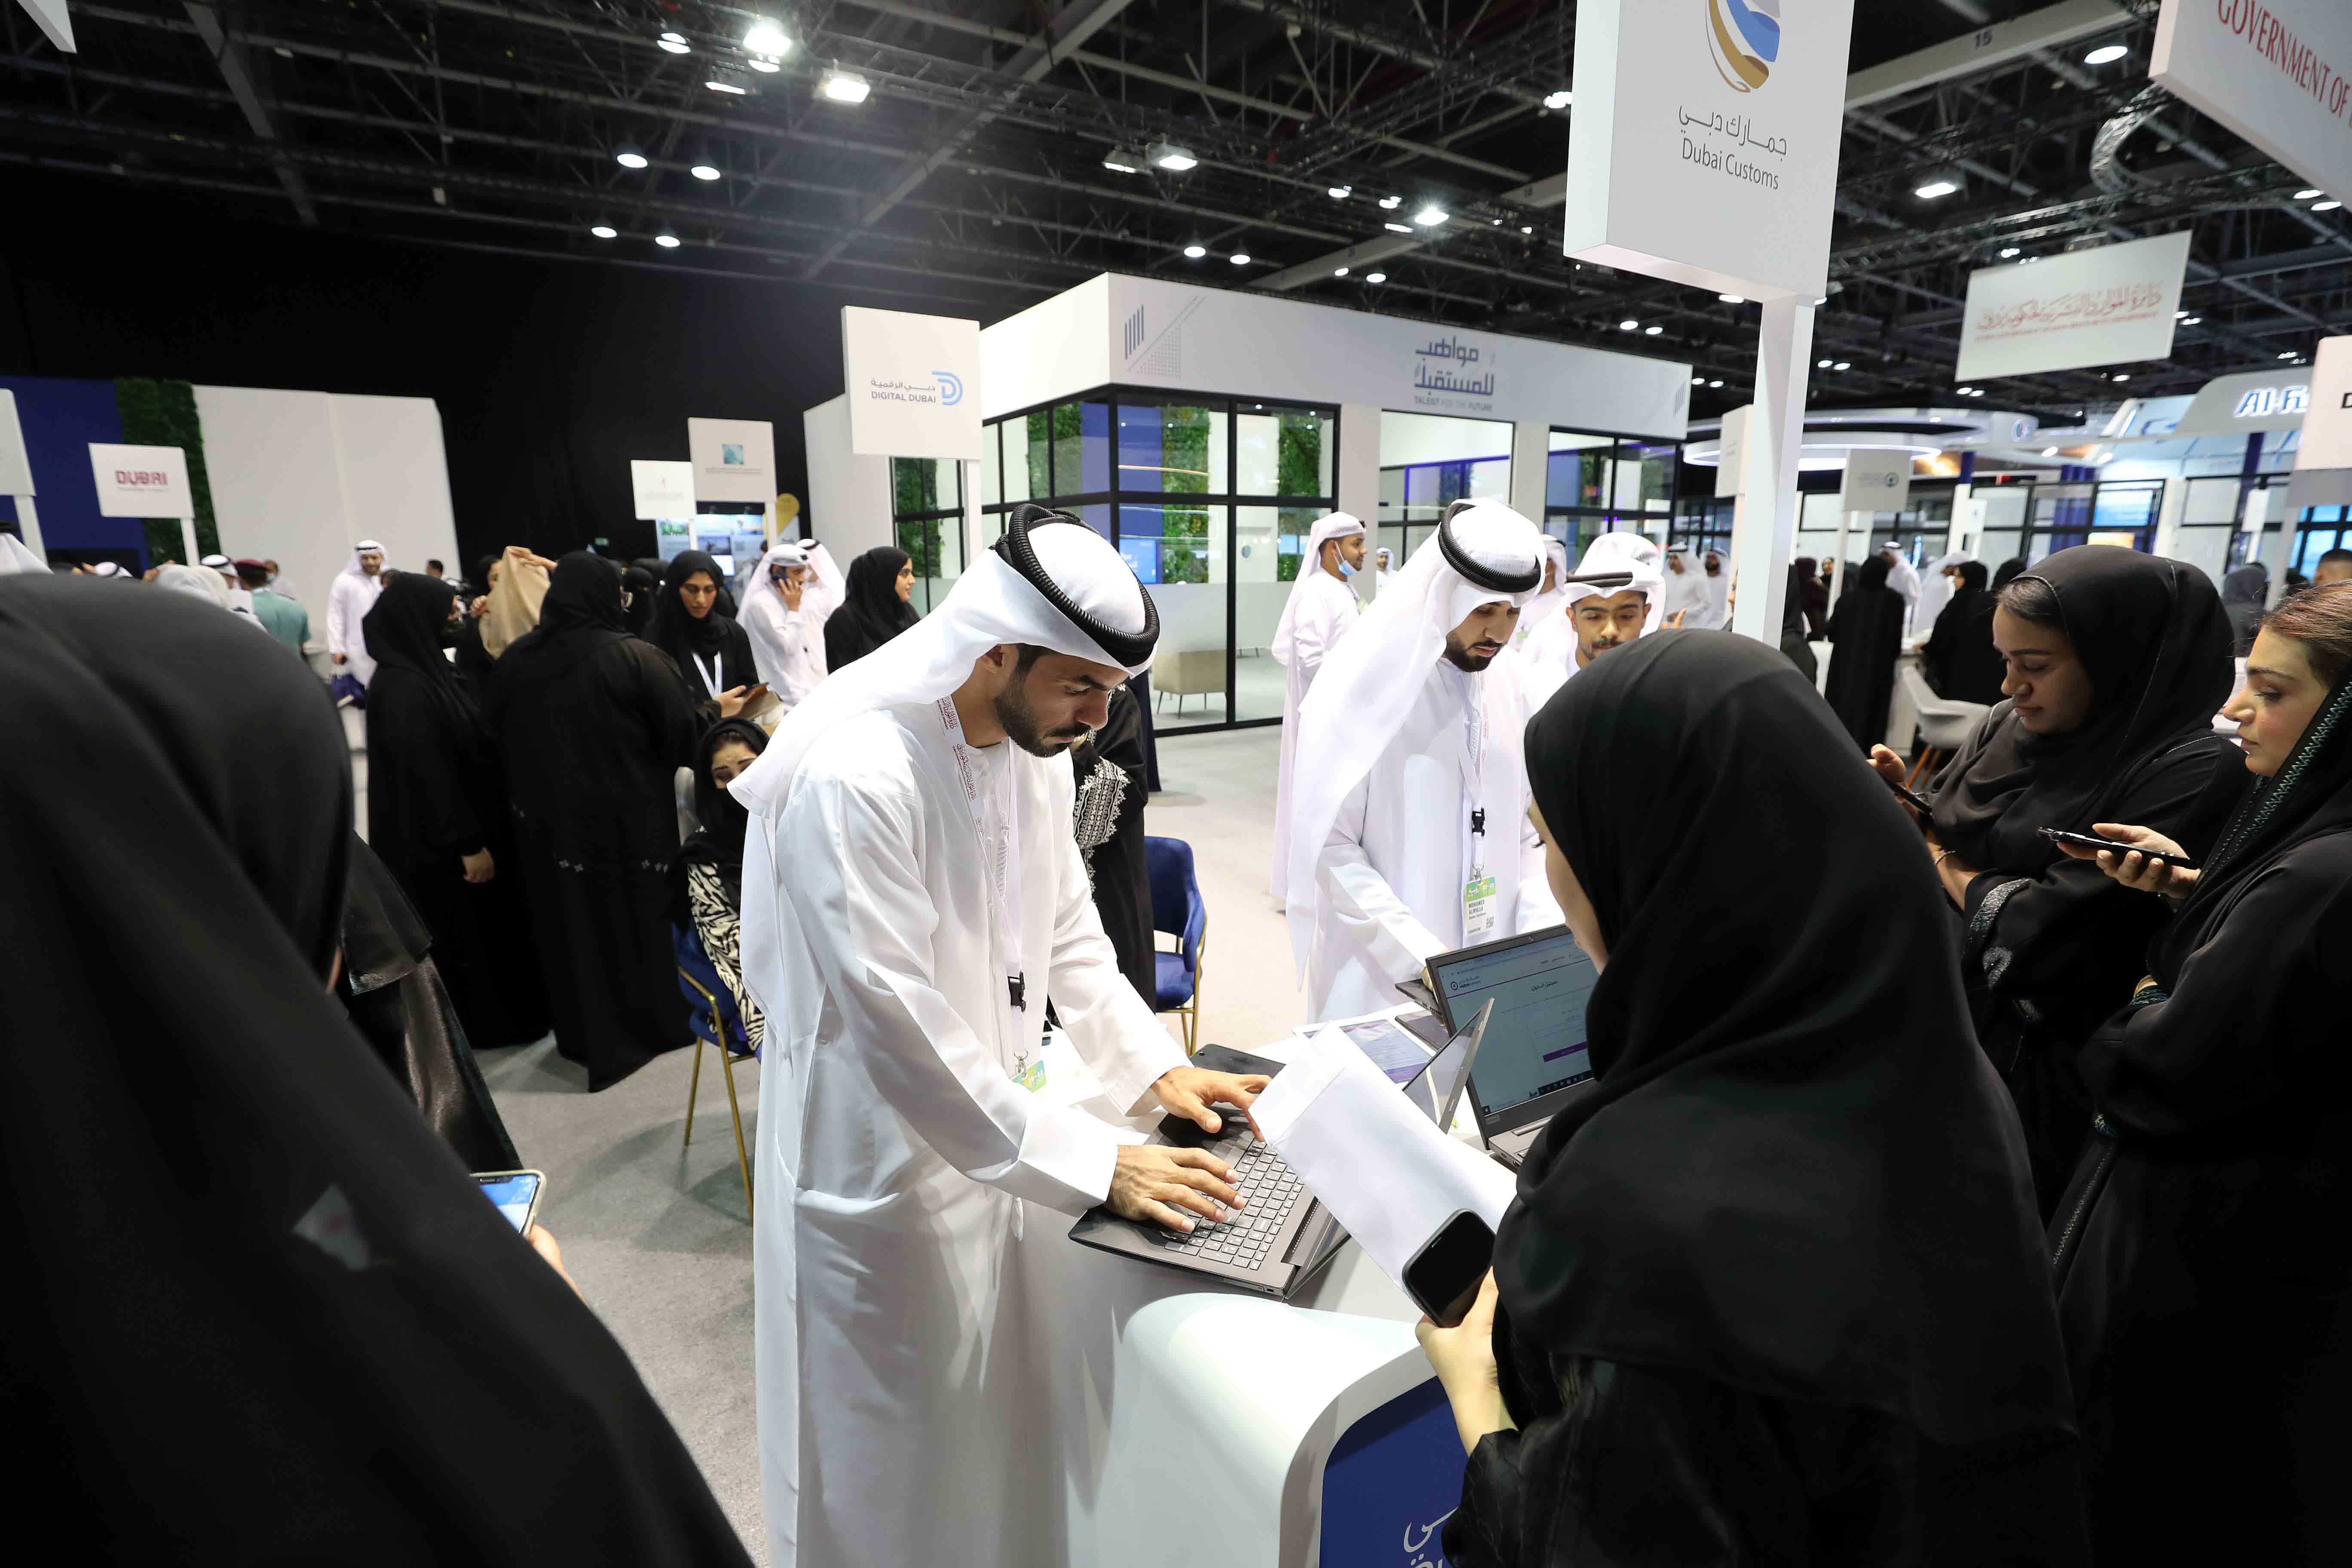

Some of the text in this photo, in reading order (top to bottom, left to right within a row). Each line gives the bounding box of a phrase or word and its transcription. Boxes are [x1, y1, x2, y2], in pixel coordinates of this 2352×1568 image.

[2218, 0, 2350, 118] GOVERNMENT OF
[1679, 105, 1787, 162] جمارك دبي
[1682, 138, 1779, 190] Dubai Customs
[871, 391, 936, 403] DIGITAL DUBAI
